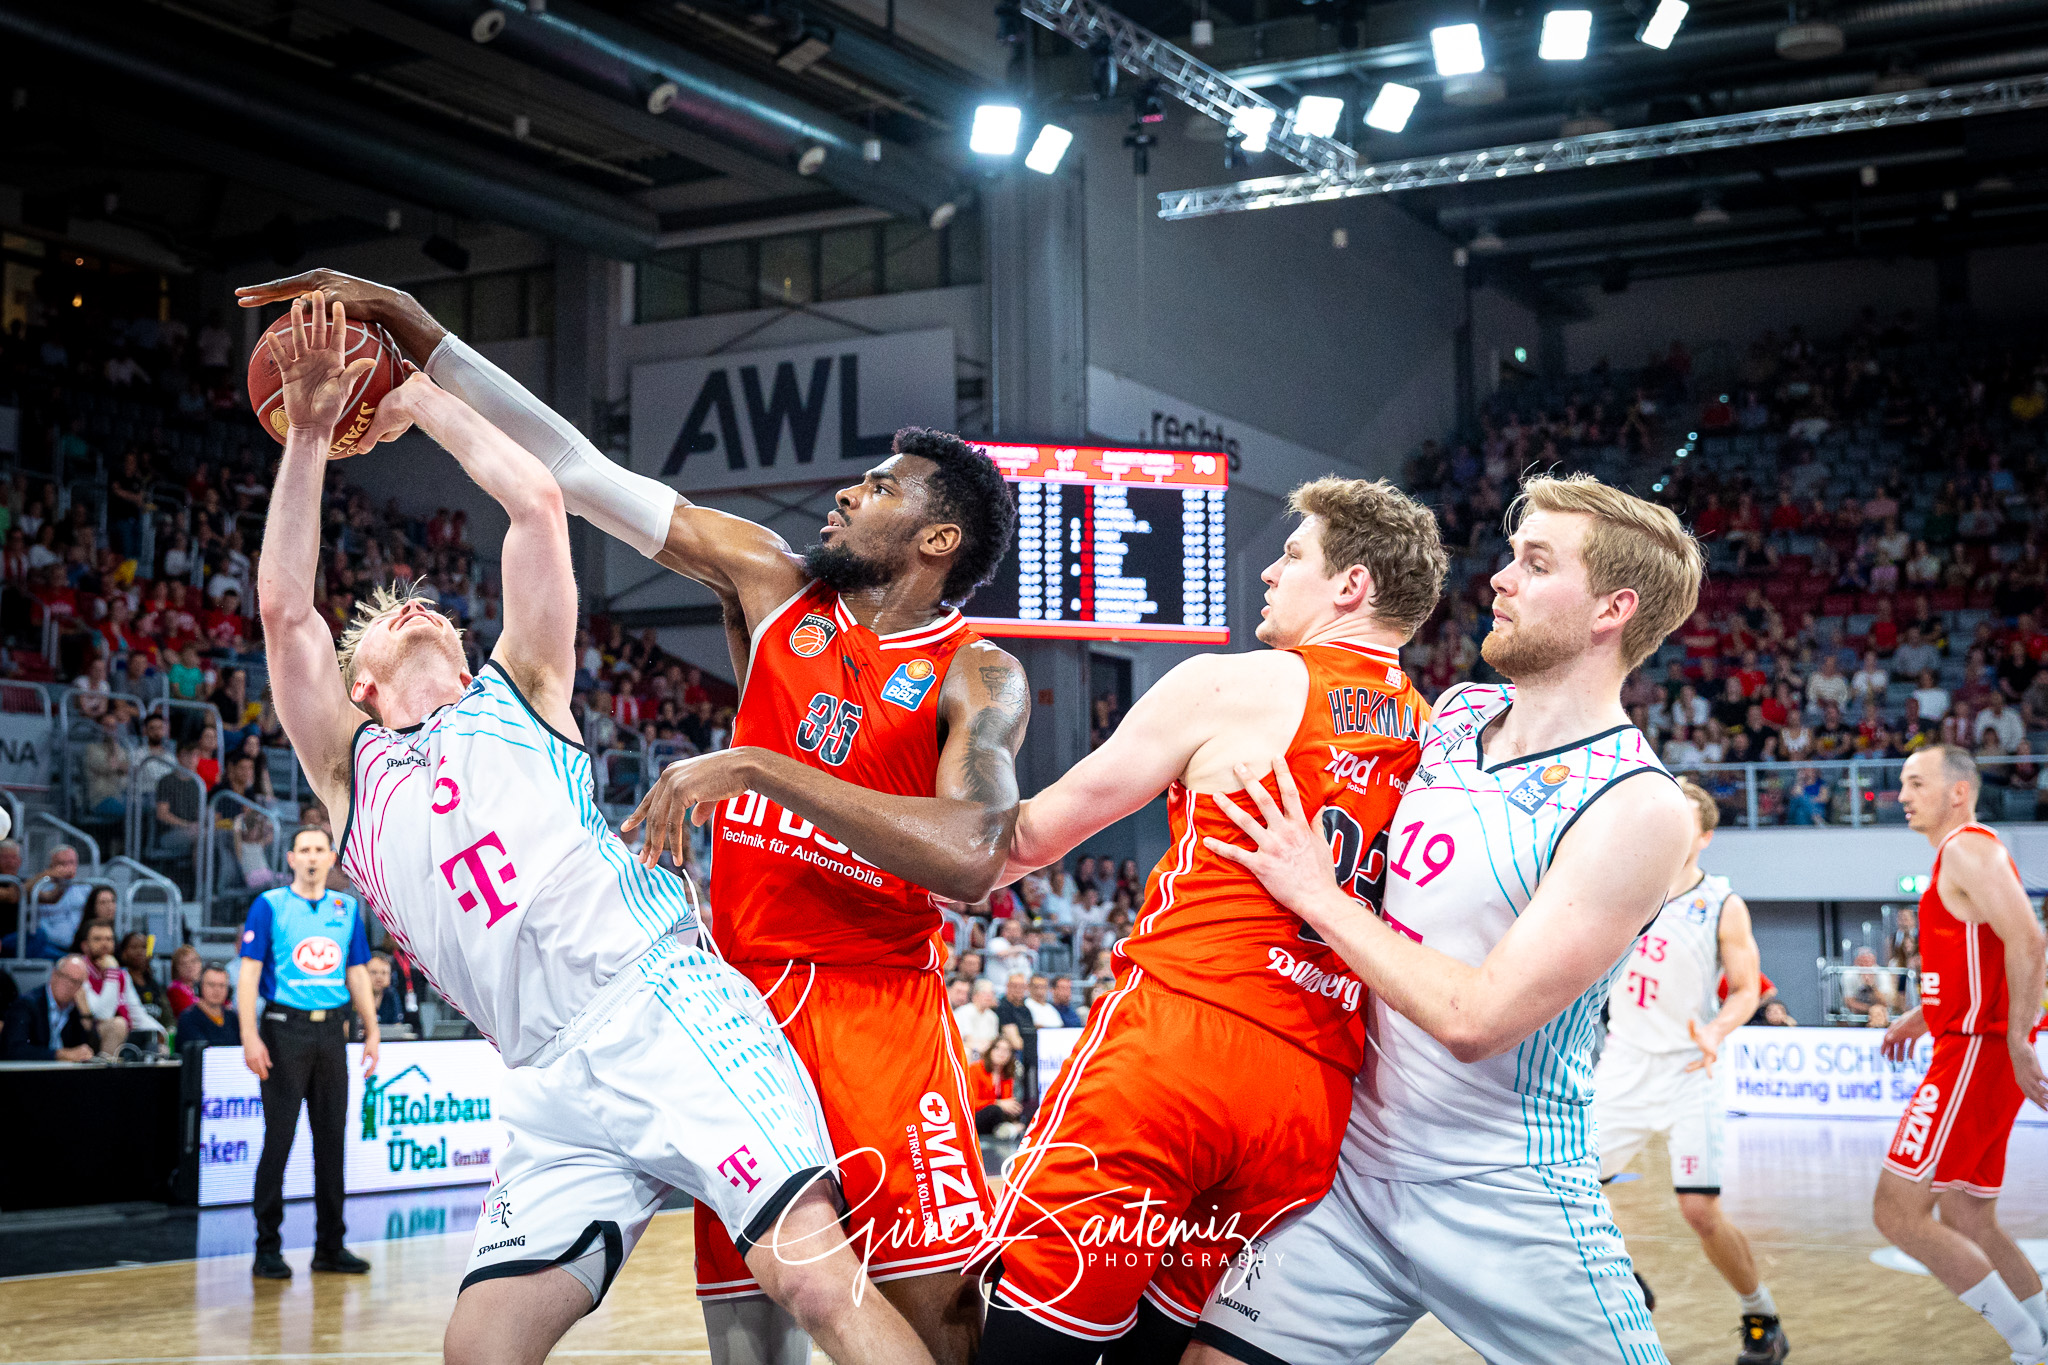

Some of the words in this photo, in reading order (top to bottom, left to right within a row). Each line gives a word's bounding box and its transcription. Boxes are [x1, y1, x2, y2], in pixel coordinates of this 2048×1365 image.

[328, 401, 376, 457] SPALD
[660, 353, 895, 477] AWL
[885, 684, 915, 706] BBL
[795, 692, 863, 767] 35
[1510, 787, 1540, 811] BBL
[722, 826, 766, 850] Technik
[769, 838, 790, 855] für
[791, 844, 884, 888] Automobile
[1389, 820, 1456, 888] 19
[1635, 934, 1668, 963] 43
[387, 1092, 491, 1126] Holzbau
[1736, 1076, 1830, 1104] Heizung
[1837, 1078, 1882, 1101] und
[1896, 1083, 1941, 1163] OMZE
[387, 1127, 447, 1172] Übel
[906, 1124, 925, 1172] STIRKAT
[916, 1173, 926, 1182] &
[477, 1235, 526, 1257] SPALDING
